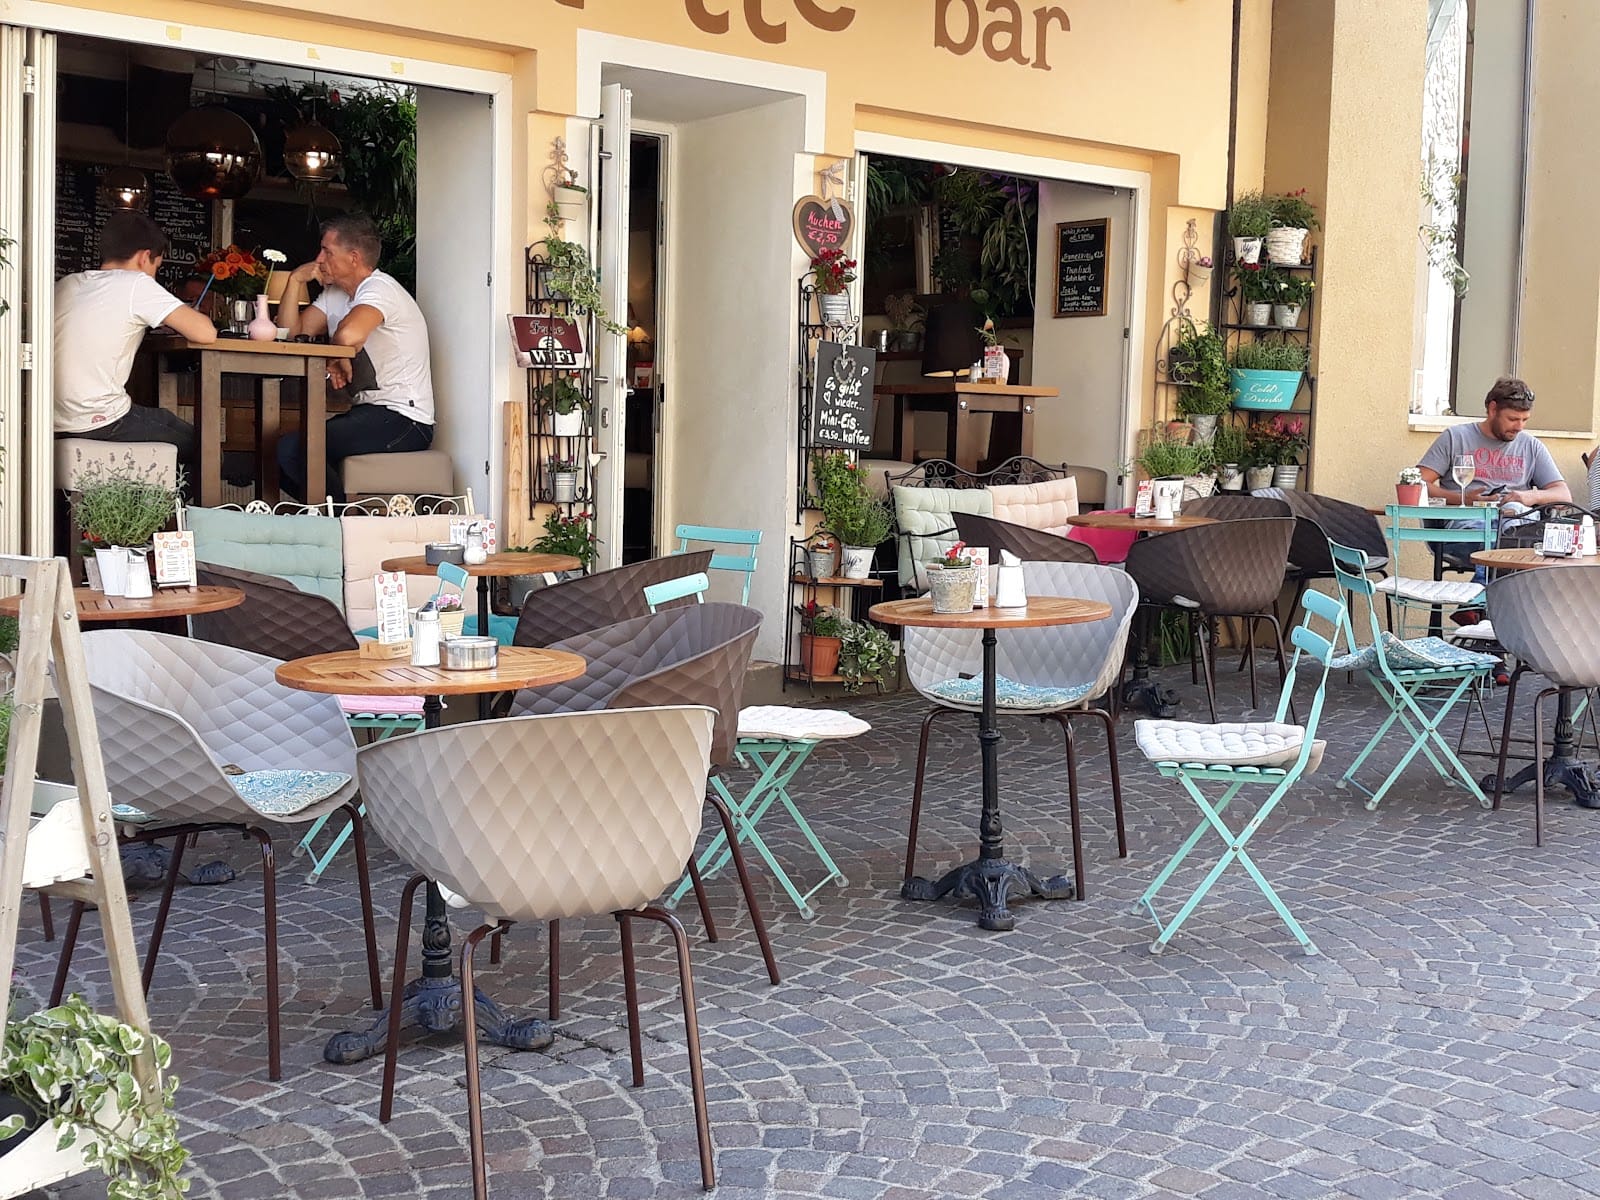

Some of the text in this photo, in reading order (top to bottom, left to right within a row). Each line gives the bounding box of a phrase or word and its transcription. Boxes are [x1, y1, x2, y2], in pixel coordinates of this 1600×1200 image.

[934, 0, 1071, 71] bar
[808, 210, 843, 230] Kuchen
[825, 376, 863, 399] Es gibt
[1243, 391, 1284, 403] Drinks
[1249, 383, 1279, 394] Cold
